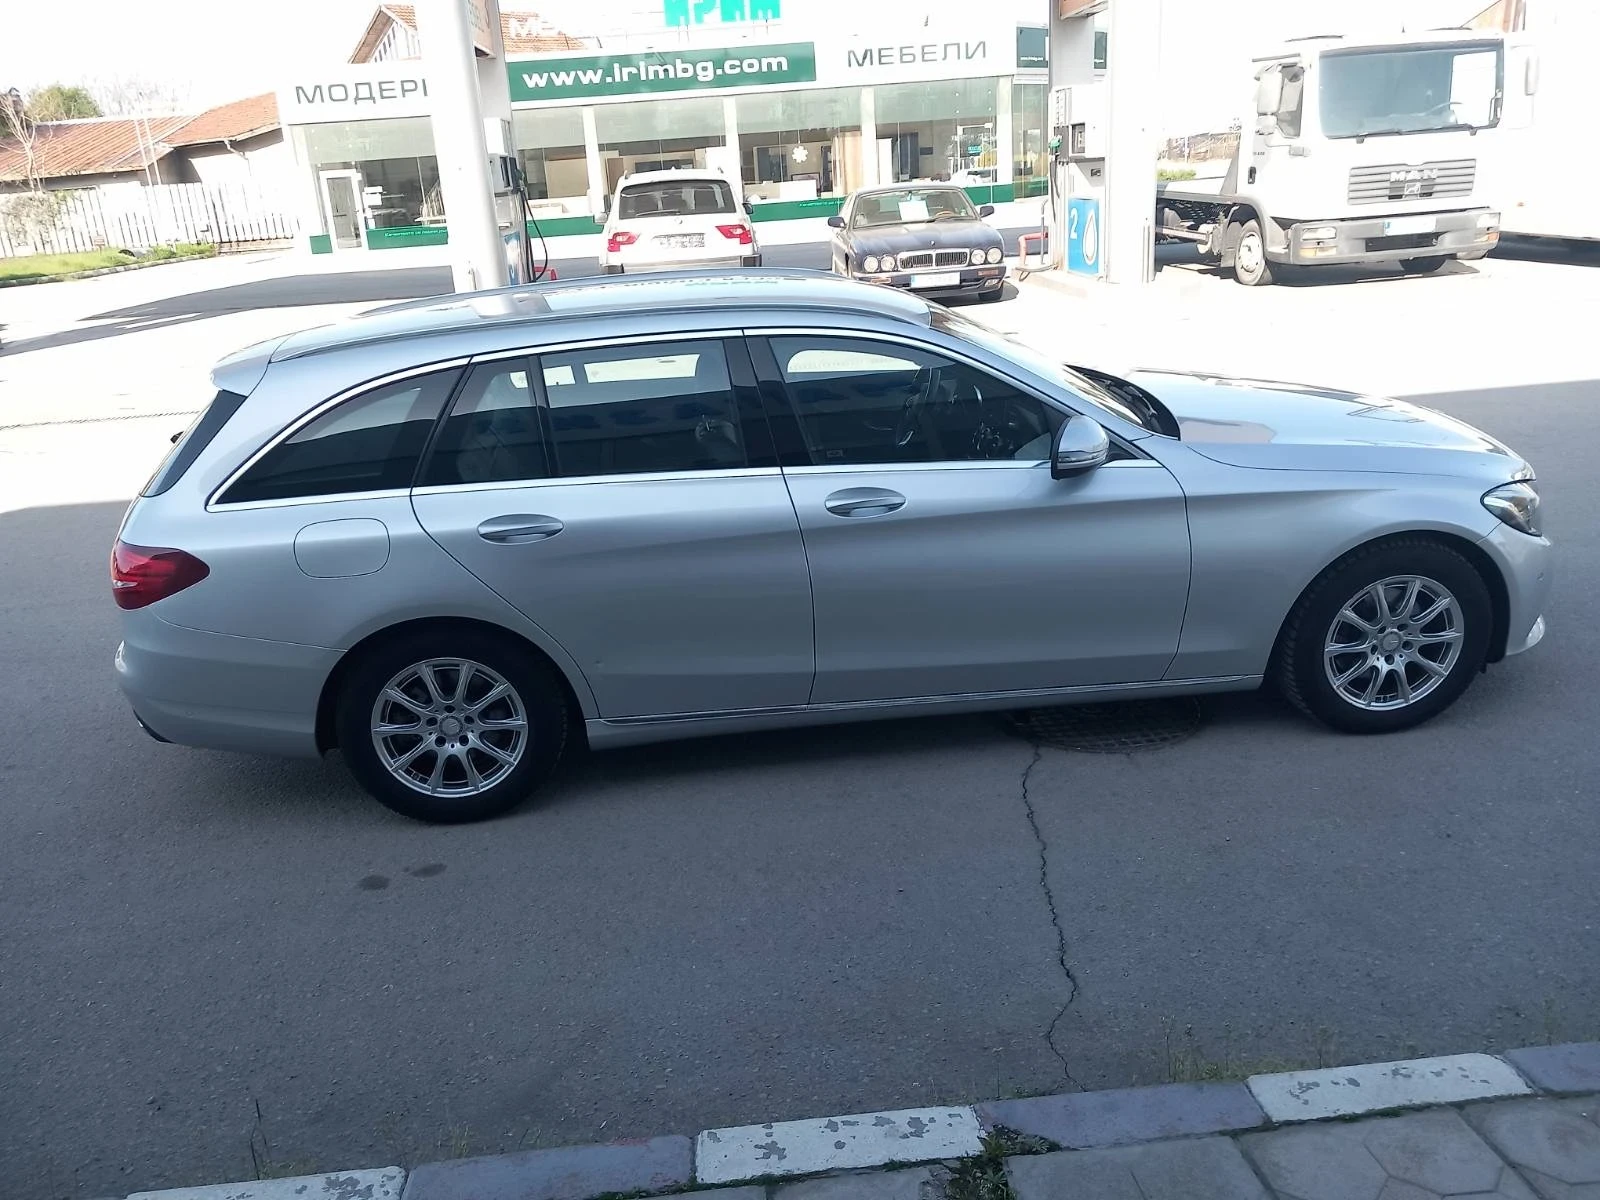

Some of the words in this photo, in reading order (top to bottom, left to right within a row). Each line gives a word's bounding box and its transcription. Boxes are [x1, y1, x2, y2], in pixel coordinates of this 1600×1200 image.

[848, 41, 986, 67] МЕБЕЛИ
[295, 79, 428, 104] МОДЕР
[1390, 168, 1438, 182] MAN
[1070, 207, 1079, 240] 2
